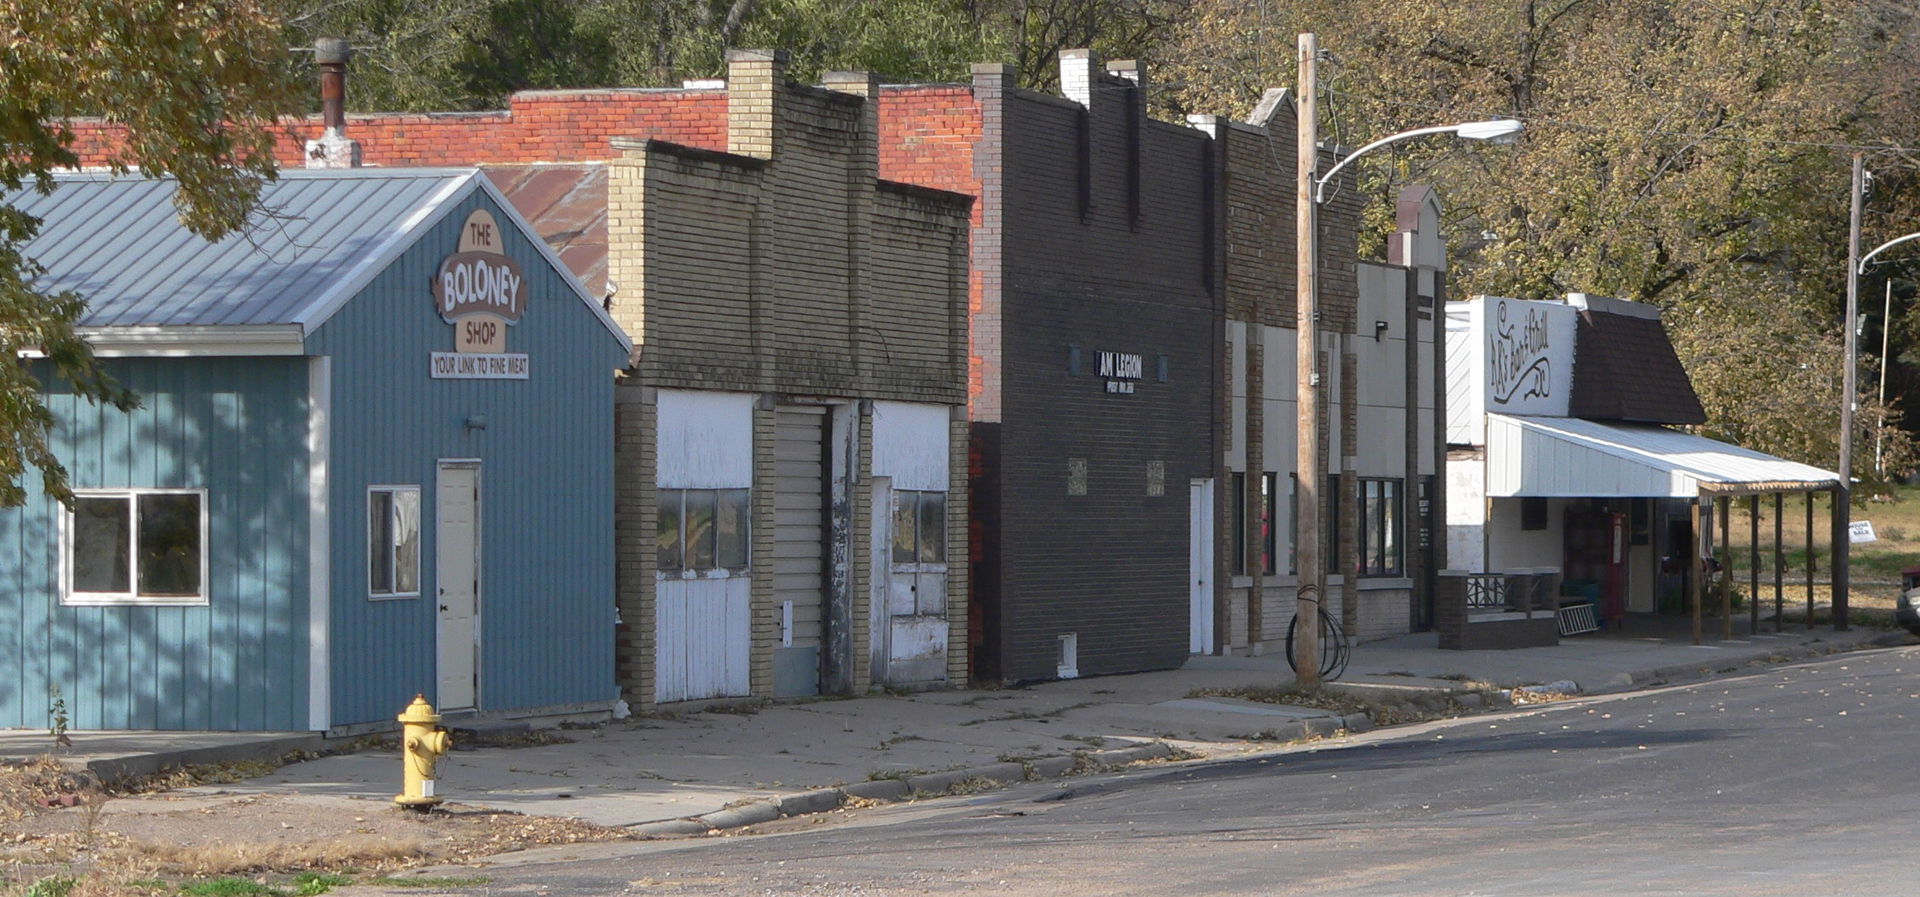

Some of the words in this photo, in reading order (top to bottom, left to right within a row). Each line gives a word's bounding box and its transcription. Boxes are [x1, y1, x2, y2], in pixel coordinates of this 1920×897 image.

[470, 223, 491, 246] THE
[444, 260, 520, 313] BOLONEY
[466, 321, 496, 345] SHOP
[1529, 307, 1549, 356] Grill
[434, 356, 456, 375] YOUR
[458, 357, 475, 375] LINK
[477, 357, 487, 375] TO
[490, 357, 506, 375] FINE
[508, 357, 527, 375] MEAT
[1100, 351, 1113, 377] AM
[1116, 352, 1142, 379] LEGION
